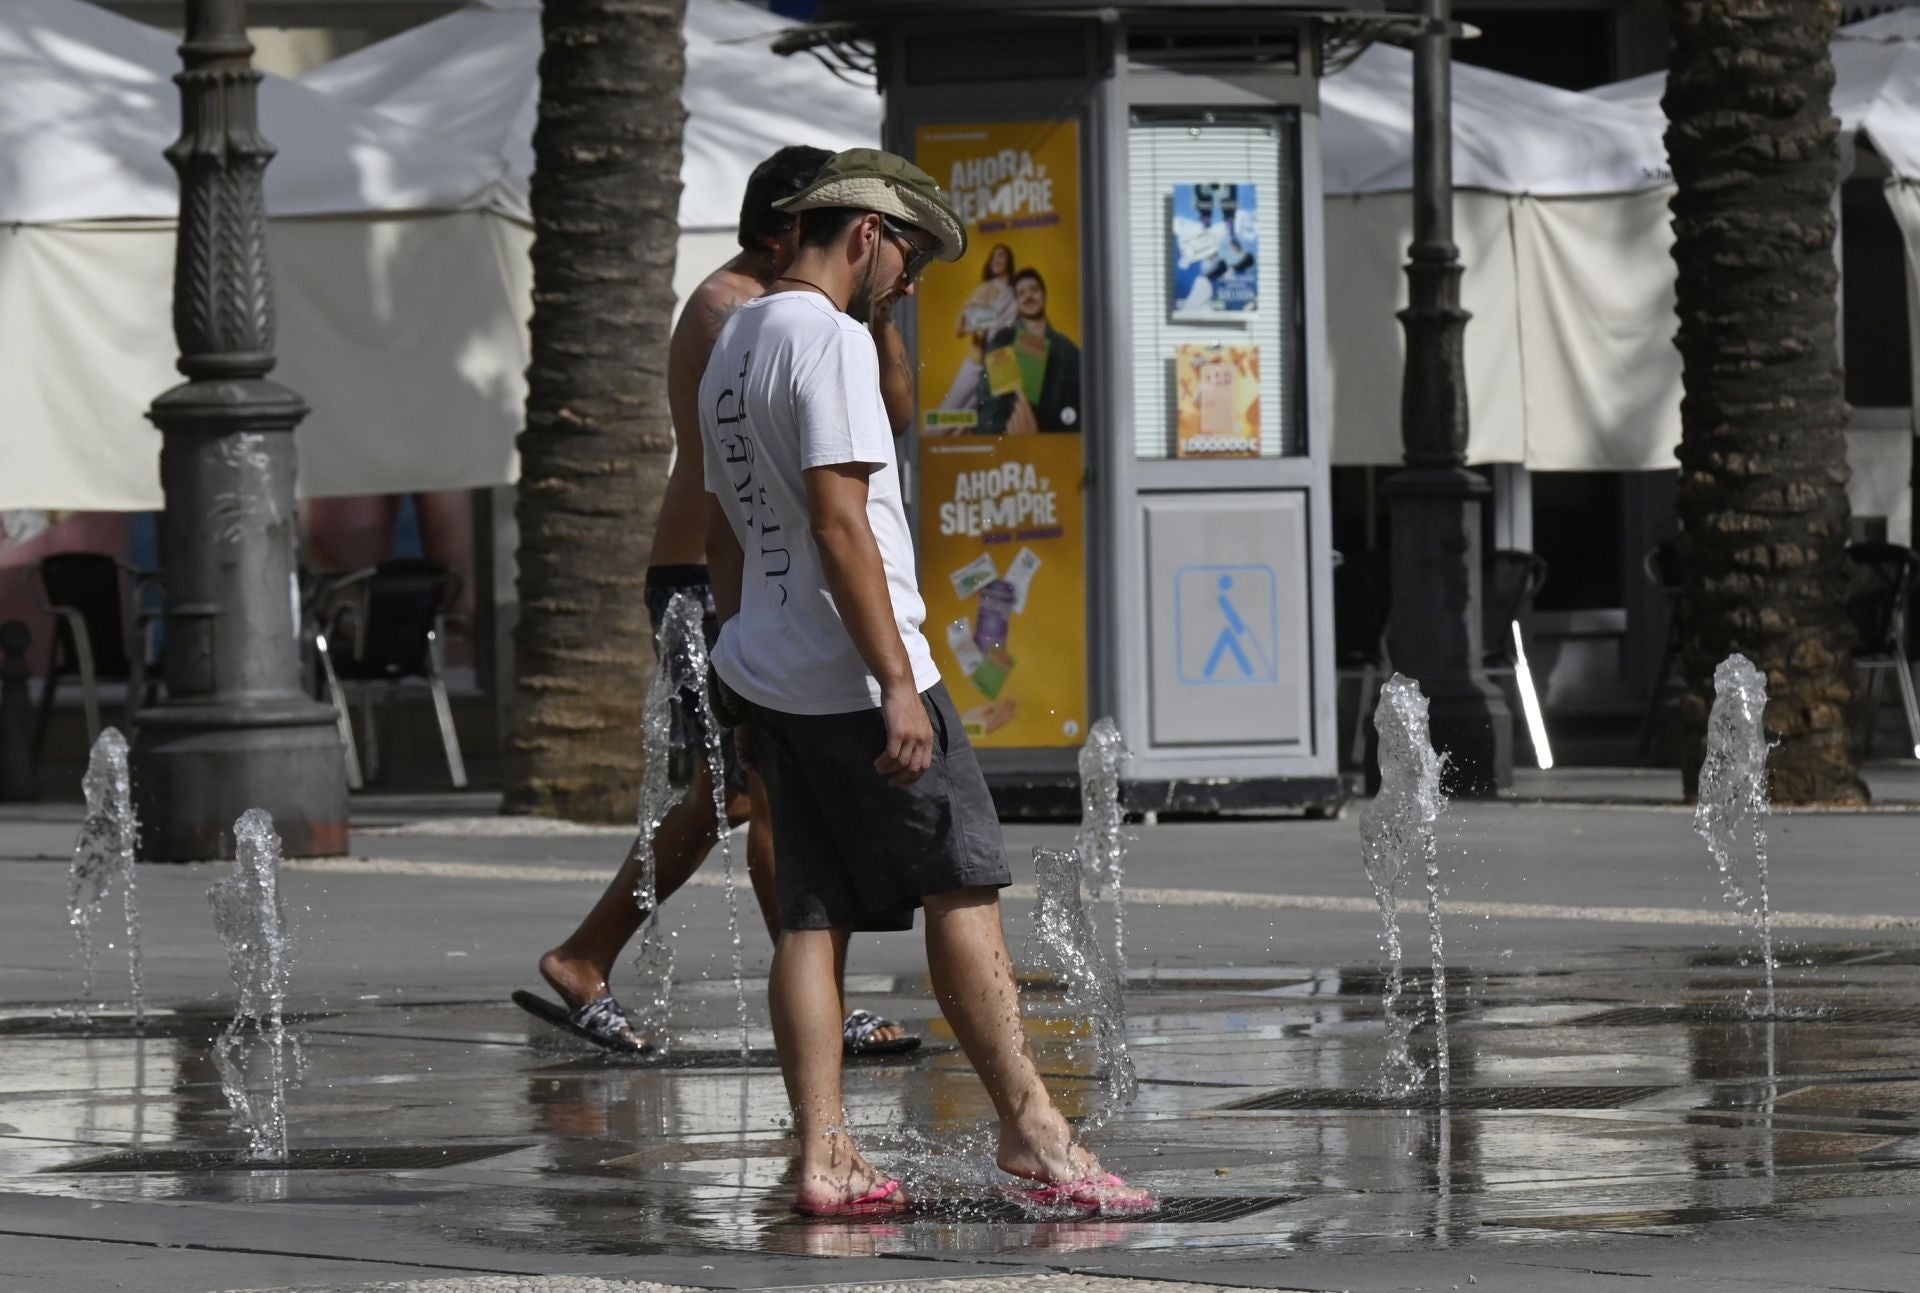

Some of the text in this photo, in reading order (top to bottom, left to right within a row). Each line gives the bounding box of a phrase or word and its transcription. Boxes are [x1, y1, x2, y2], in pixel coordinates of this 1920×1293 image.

[952, 148, 1034, 189] AHORA
[955, 461, 1037, 501] AHORA
[939, 491, 1057, 537] SIEMPRE
